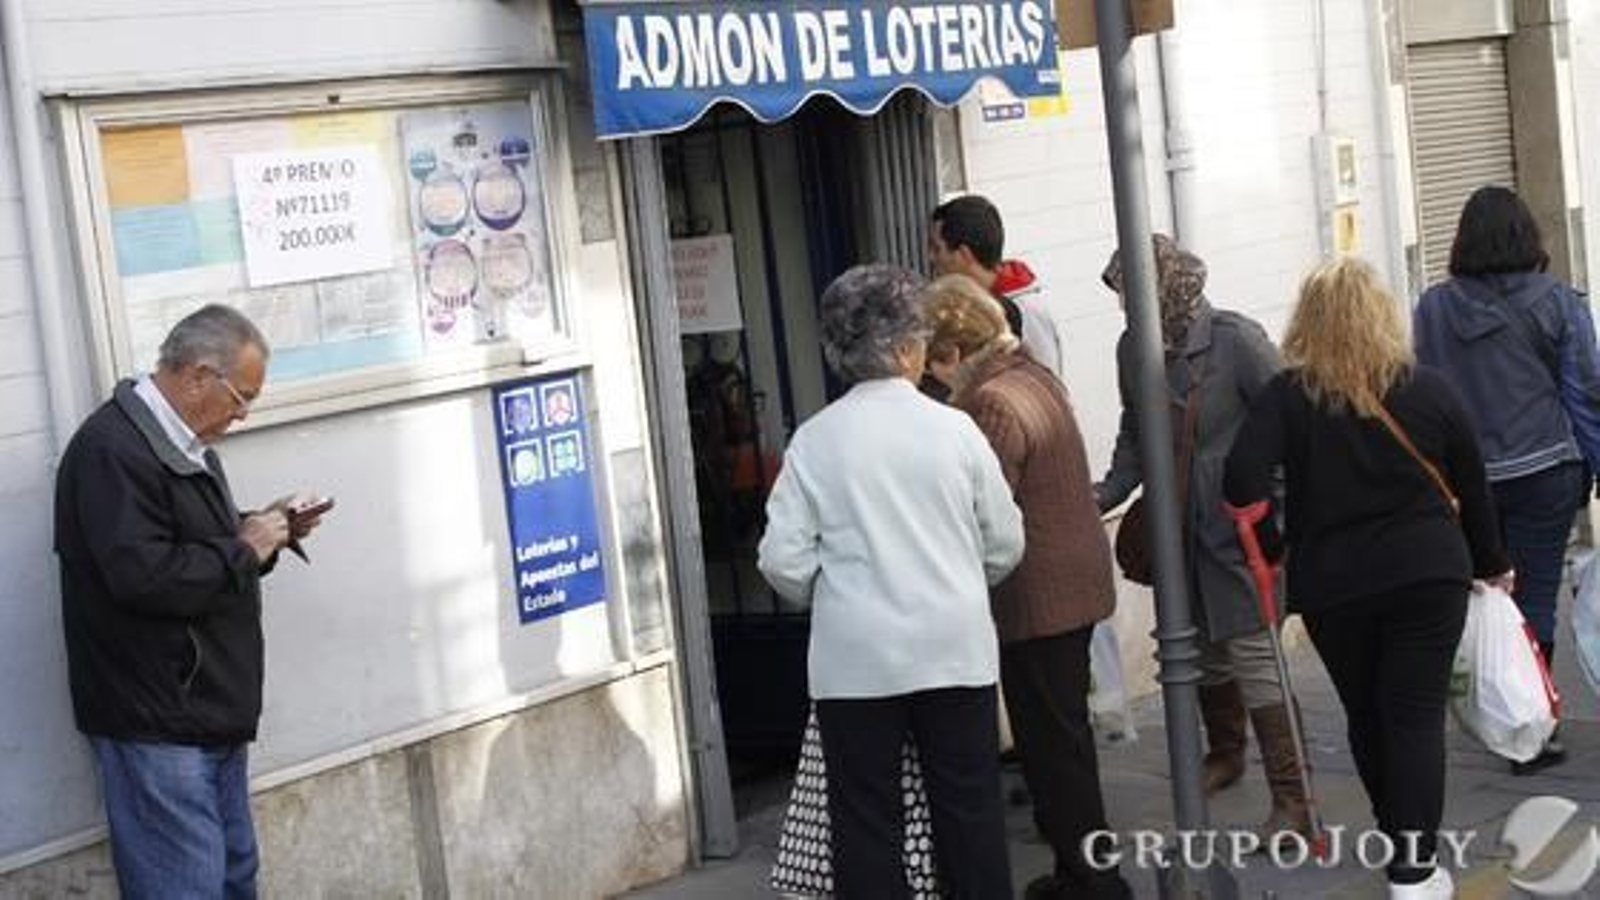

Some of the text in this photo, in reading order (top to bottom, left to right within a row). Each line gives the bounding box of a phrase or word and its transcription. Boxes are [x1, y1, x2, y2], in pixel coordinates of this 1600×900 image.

[616, 1, 1045, 89] ADMON DE LOTERIAS
[524, 587, 566, 611] Estado
